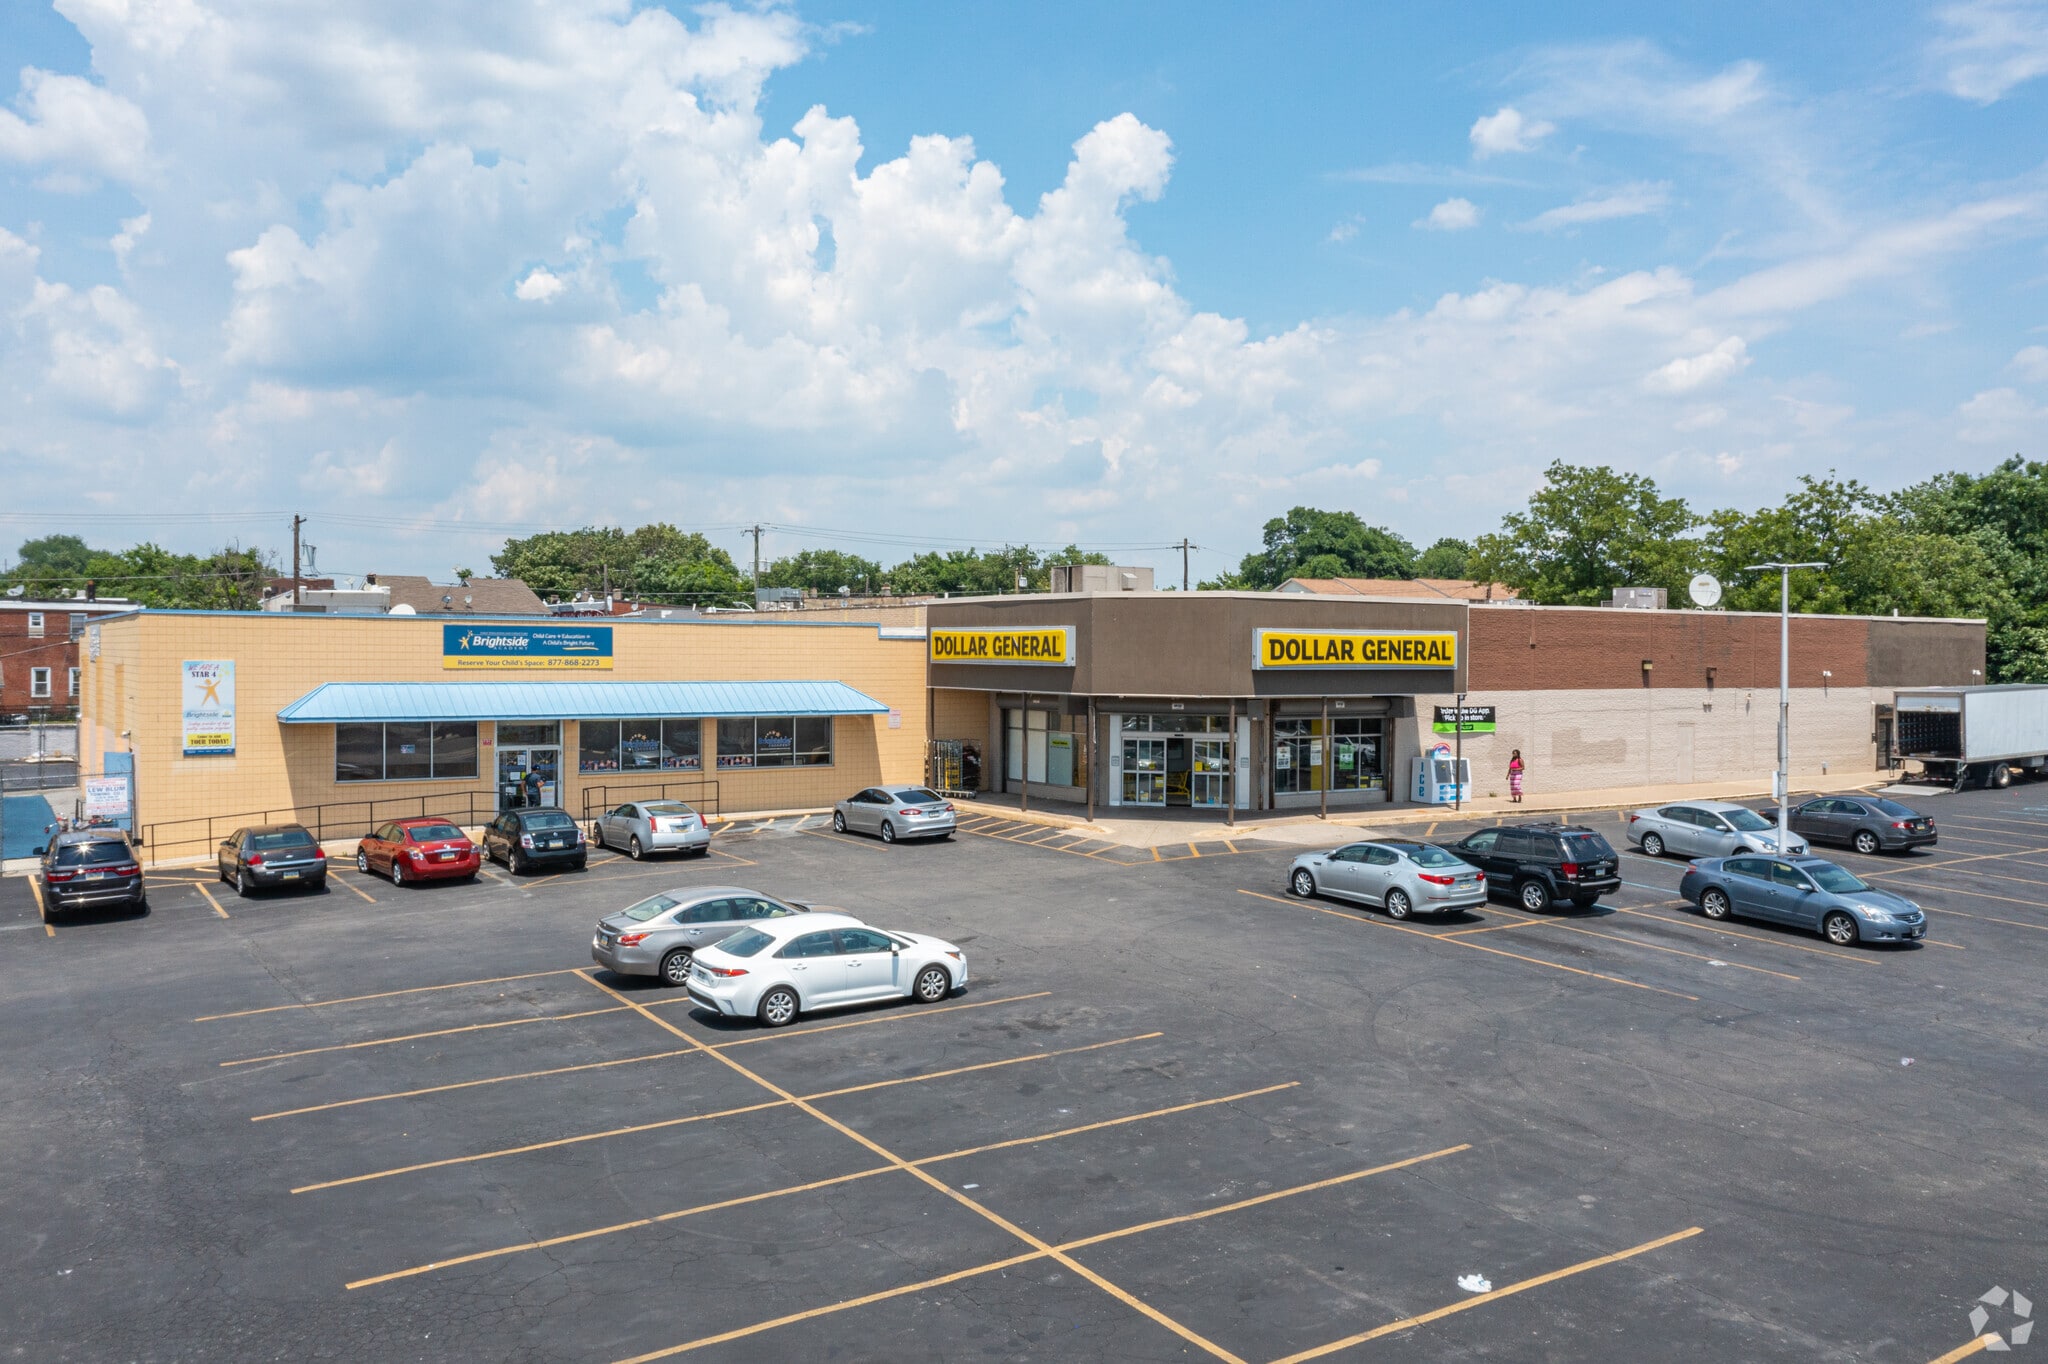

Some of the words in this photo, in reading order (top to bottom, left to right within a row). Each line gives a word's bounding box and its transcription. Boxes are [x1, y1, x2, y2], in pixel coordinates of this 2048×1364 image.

[472, 635, 529, 649] Brightside
[934, 635, 988, 656] DOLLAR
[992, 635, 1061, 657] GENERAL
[1268, 638, 1354, 661] DOLLAR
[1362, 638, 1452, 661] GENERAL
[524, 659, 545, 668] Space:
[547, 659, 600, 667] 877-868-2273
